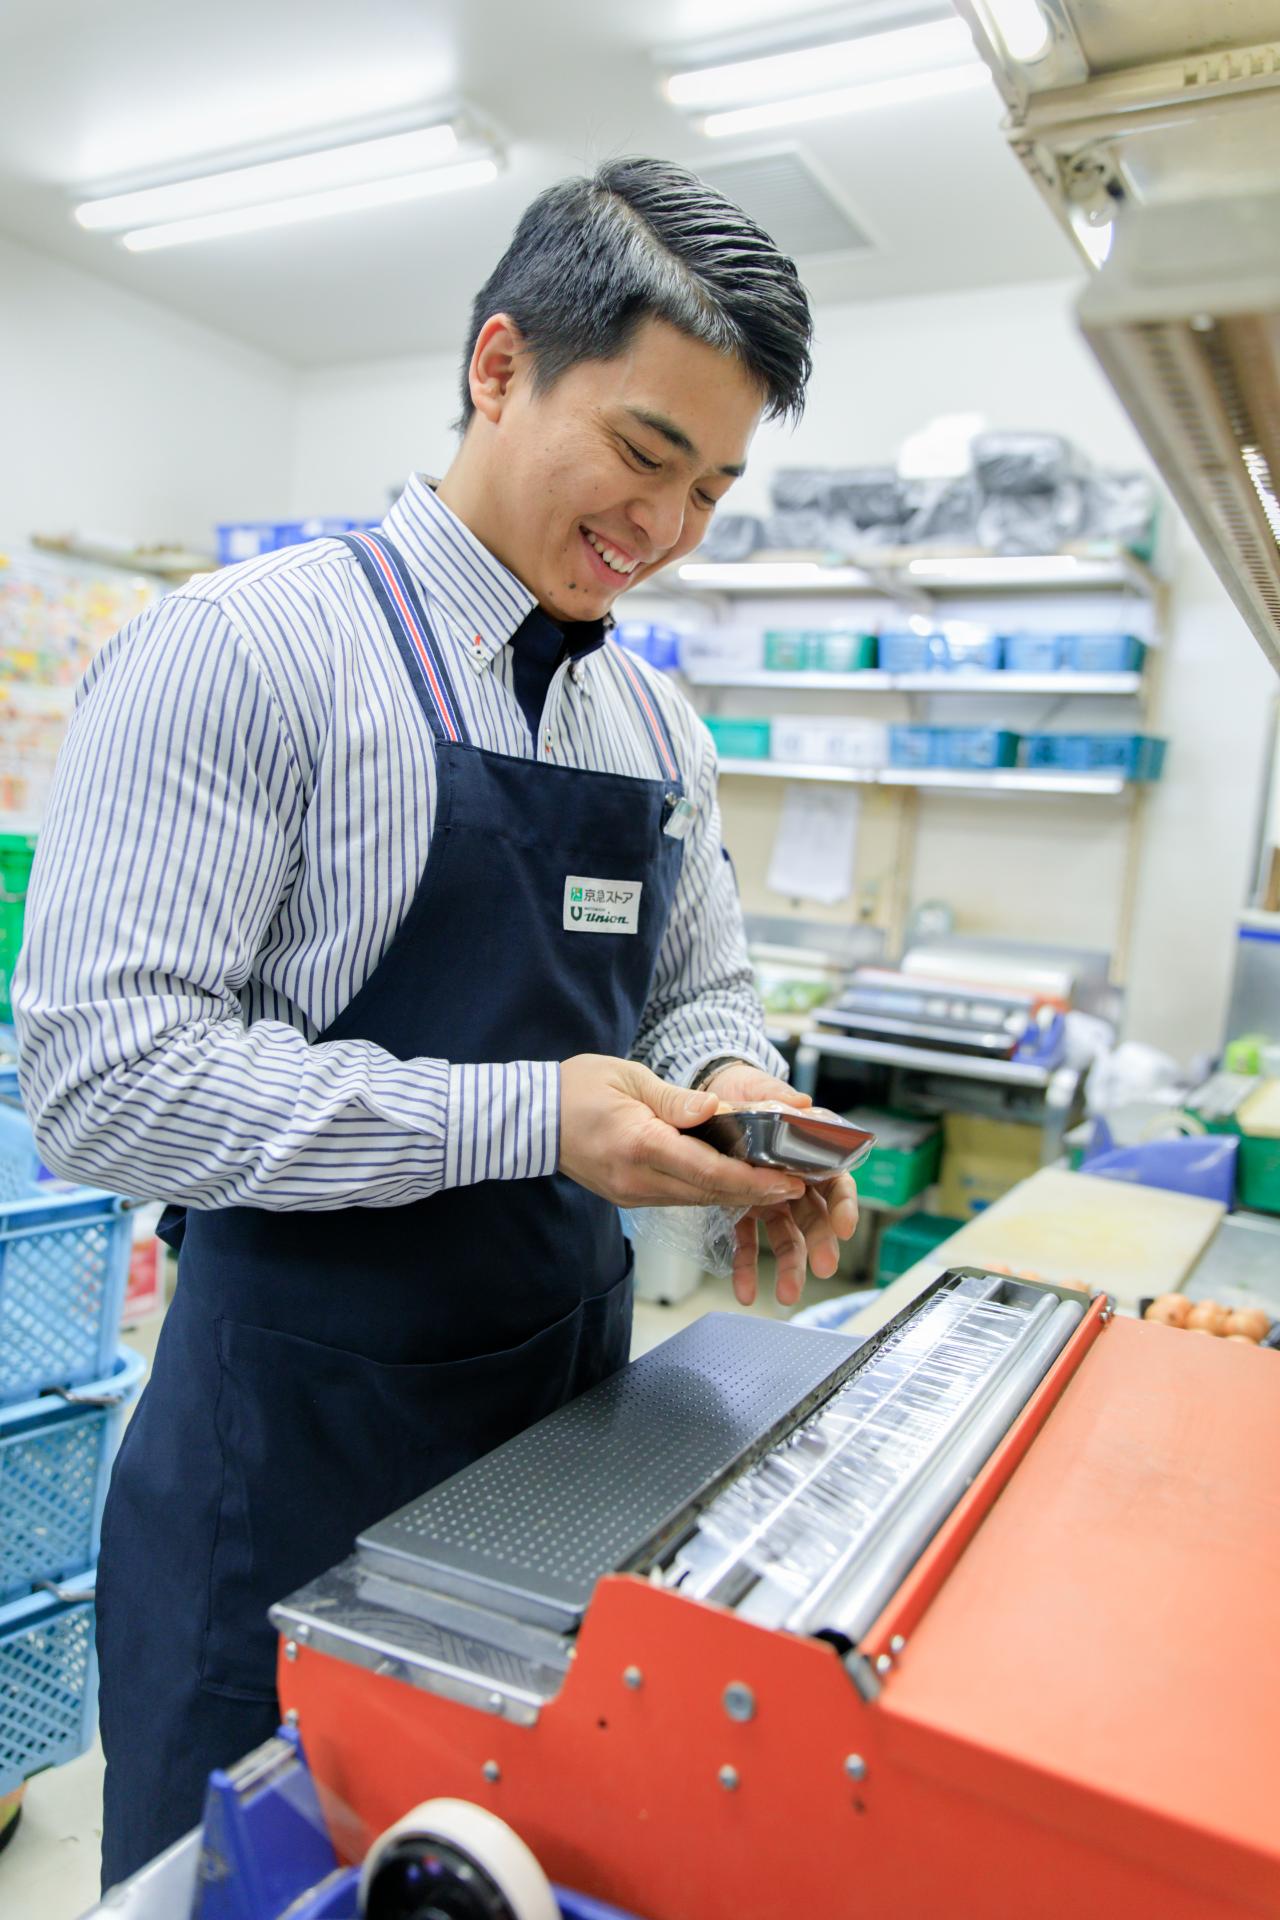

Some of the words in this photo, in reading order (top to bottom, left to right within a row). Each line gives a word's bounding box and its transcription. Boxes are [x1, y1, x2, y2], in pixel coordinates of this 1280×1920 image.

[584, 889, 633, 904] 京急ストア
